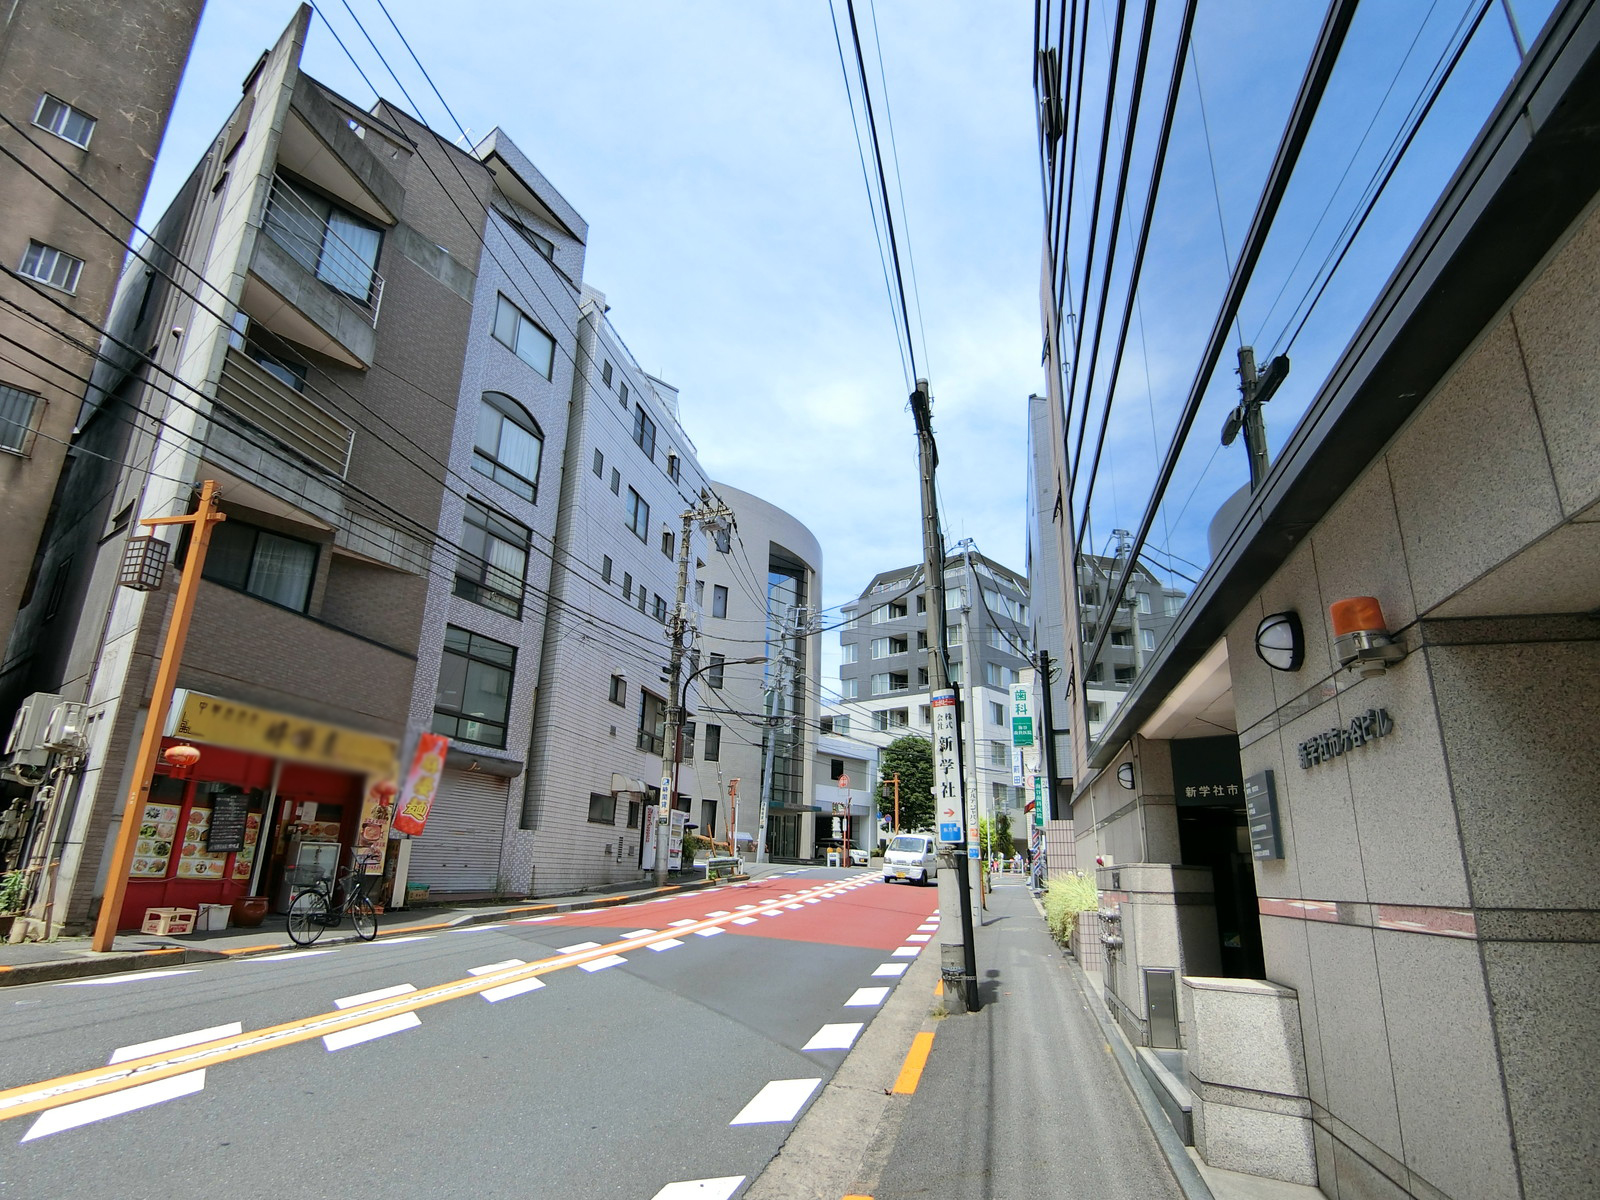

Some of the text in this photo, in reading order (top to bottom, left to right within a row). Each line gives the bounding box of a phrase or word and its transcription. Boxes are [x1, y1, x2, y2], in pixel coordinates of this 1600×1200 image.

[1014, 689, 1028, 715] 歯科
[937, 713, 944, 730] 会社
[944, 712, 953, 729] 株式
[939, 736, 956, 798] 新学社
[1185, 784, 1245, 798] 新学社市
